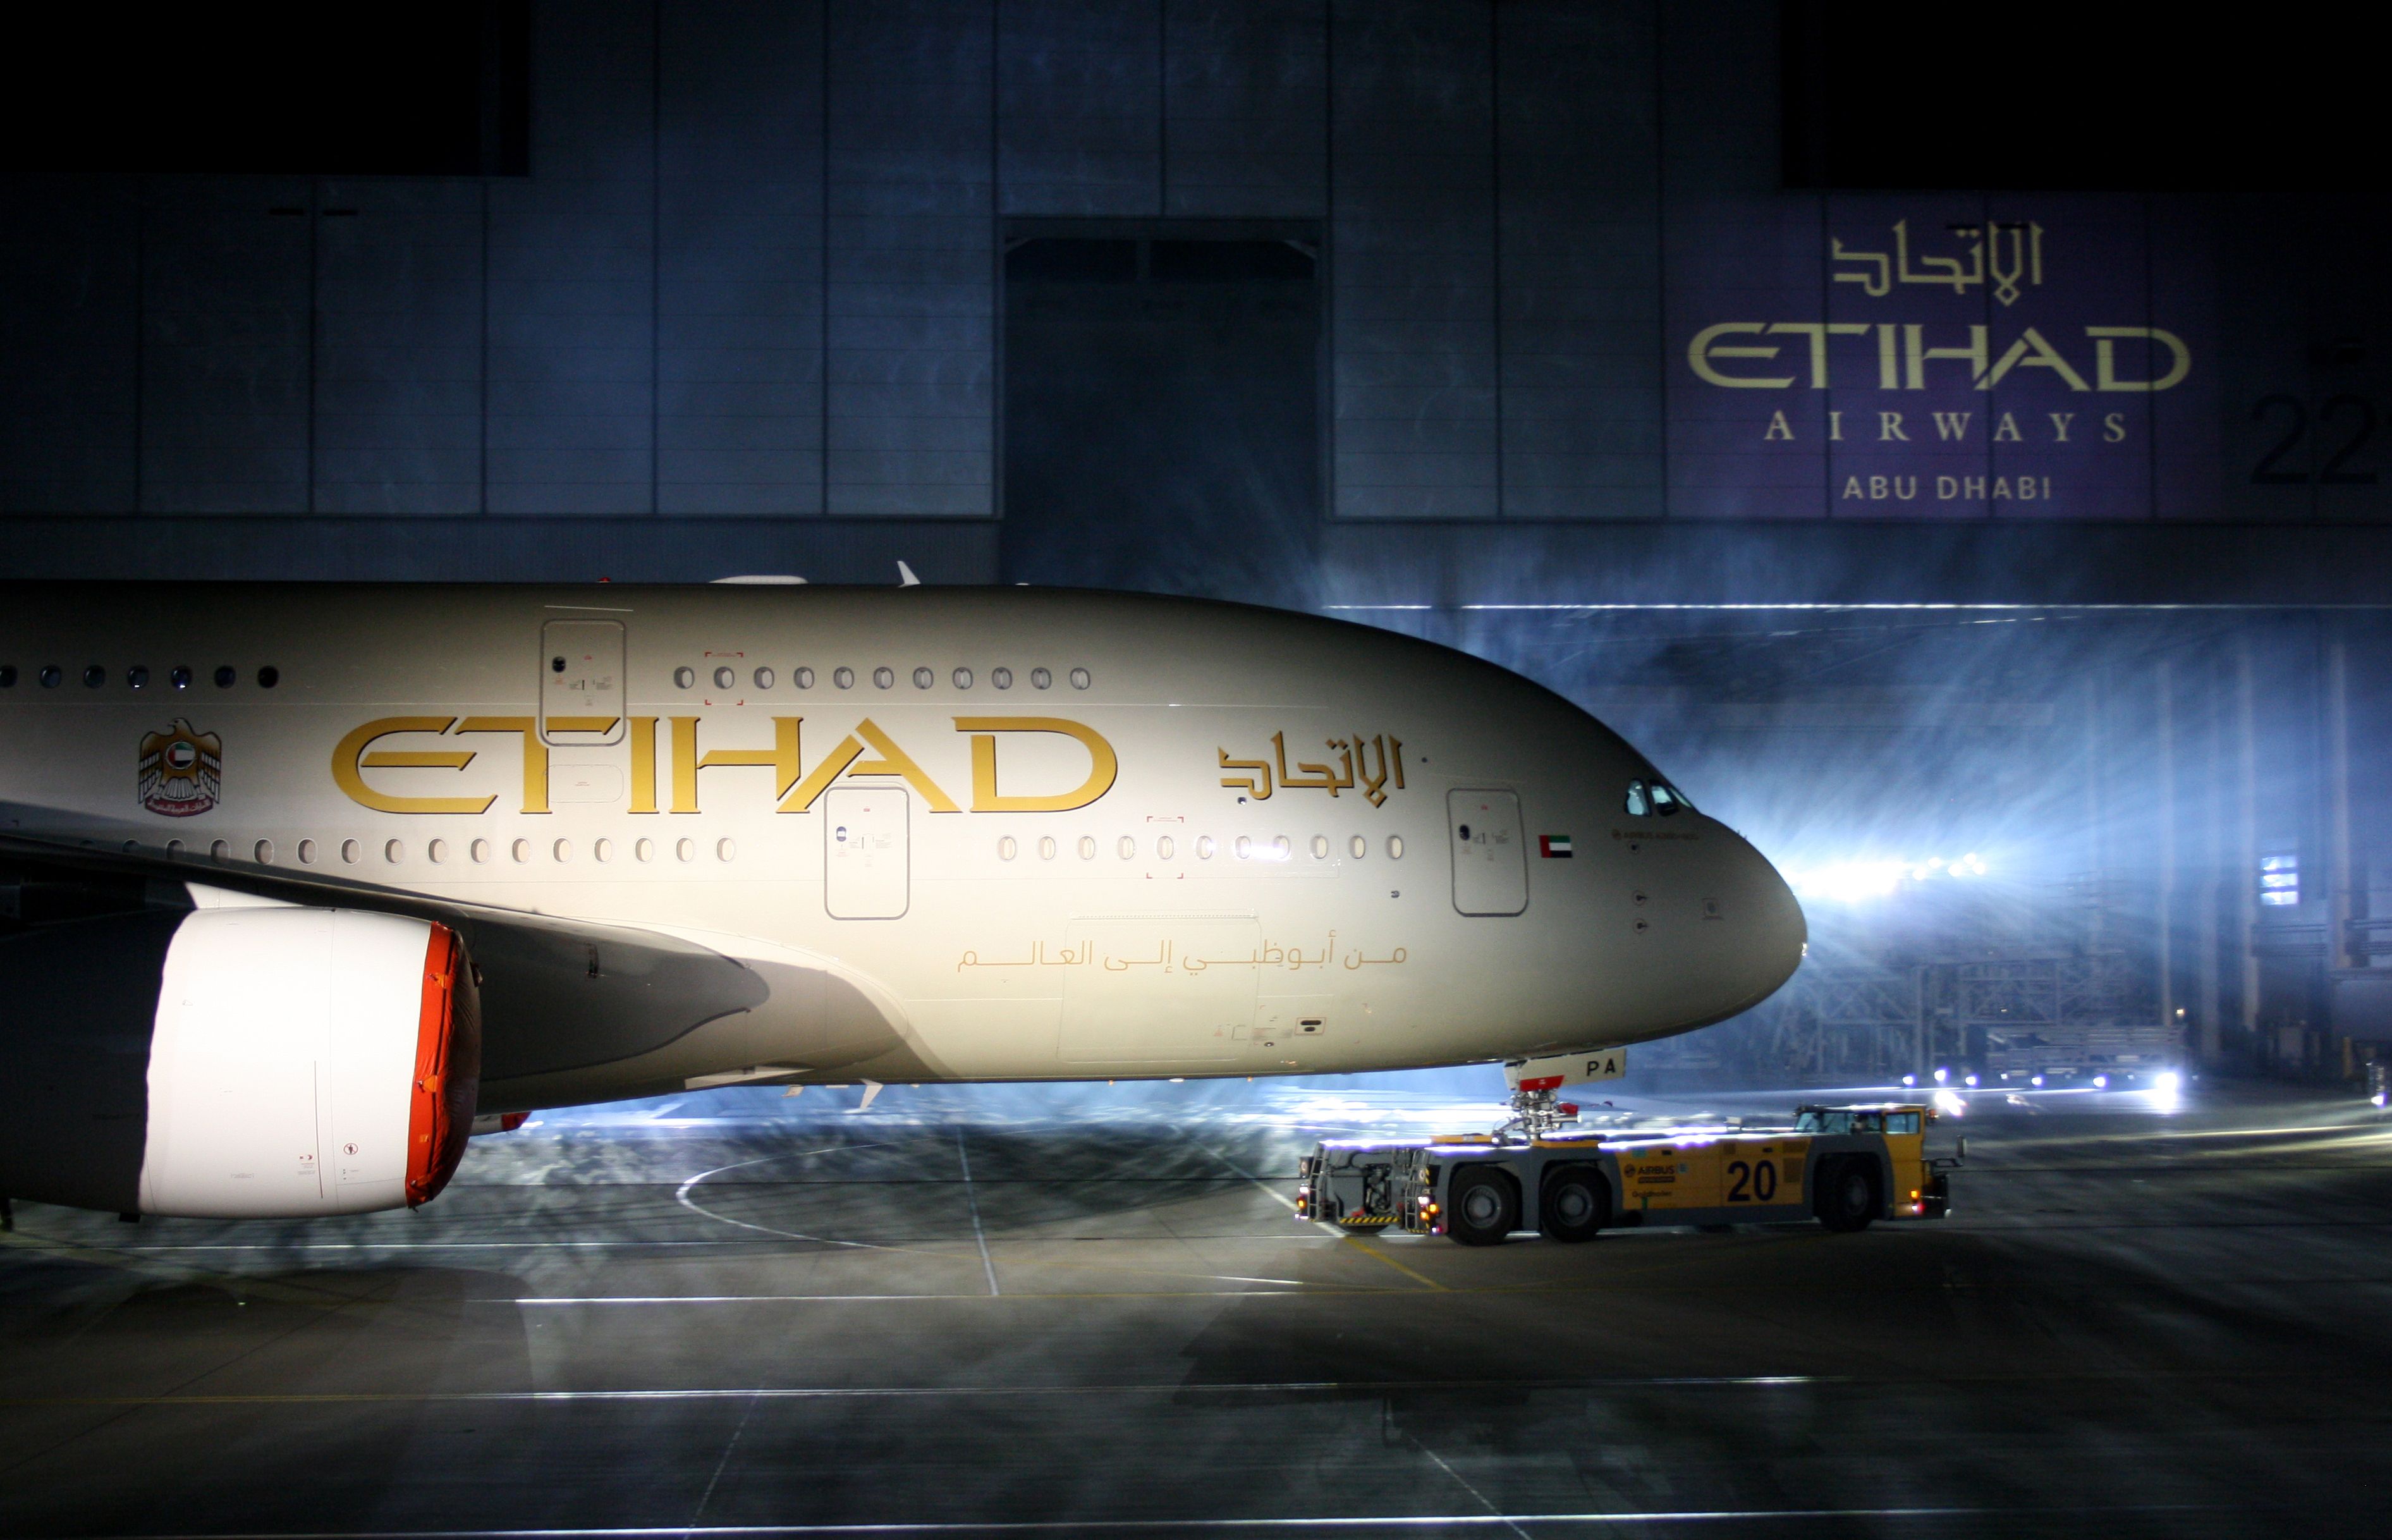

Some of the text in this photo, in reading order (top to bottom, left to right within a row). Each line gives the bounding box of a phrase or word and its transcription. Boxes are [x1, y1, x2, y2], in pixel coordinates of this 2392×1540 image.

[1687, 322, 2192, 392] ETIHAD
[1764, 410, 2127, 442] AIRWAYS
[2251, 393, 2377, 484] 22
[1843, 476, 2051, 500] ABU DHABI
[331, 716, 1118, 814] ETIHAD
[958, 939, 1092, 972] العالم
[1104, 939, 1173, 973] إلى
[1344, 947, 1407, 970] من
[1638, 1164, 1675, 1175] AIRBUS
[1727, 1159, 1777, 1202] 20
